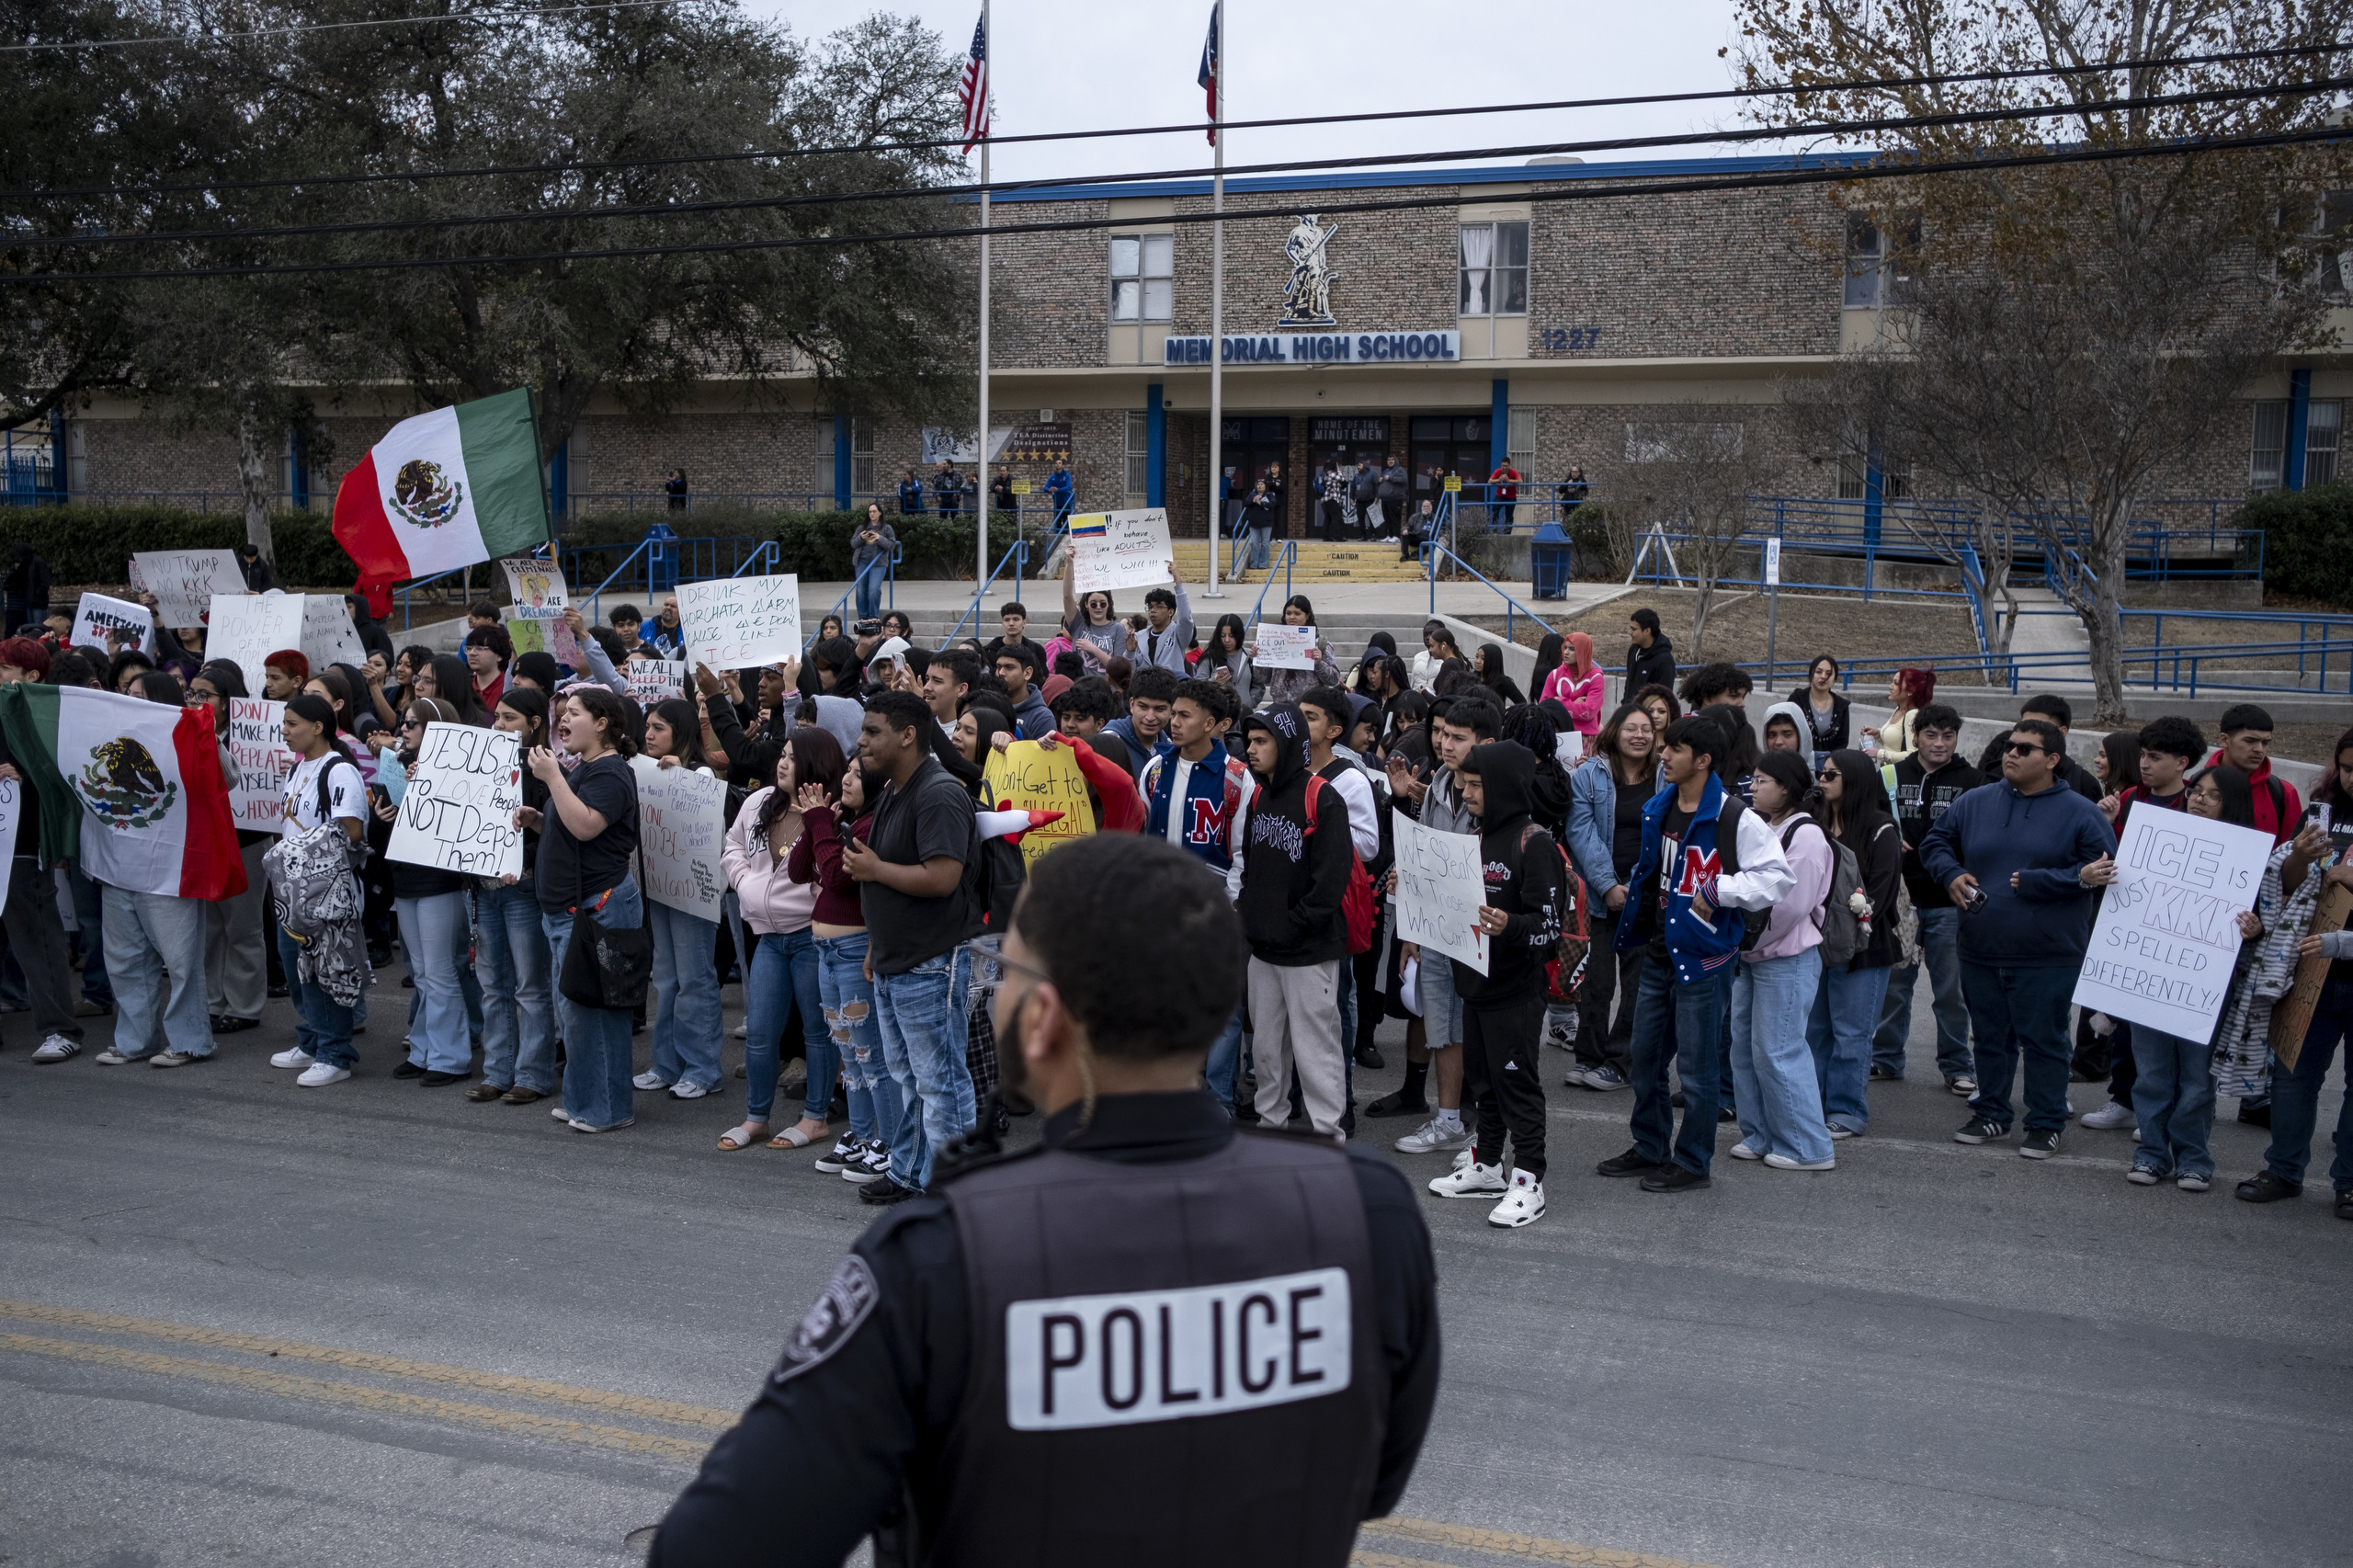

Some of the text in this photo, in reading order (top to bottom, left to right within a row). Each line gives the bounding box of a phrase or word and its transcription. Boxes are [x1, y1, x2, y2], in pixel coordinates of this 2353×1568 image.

[1166, 334, 1454, 362] MEMORIAL HIGH SCHOOL
[1541, 327, 1600, 348] 1227
[1314, 429, 1382, 440] MINUTEMEN
[1318, 420, 1342, 429] HOME
[1363, 420, 1380, 429] THE
[1127, 519, 1138, 529] you
[152, 555, 219, 575] NO TRUMP
[157, 579, 173, 593] NO
[182, 575, 215, 594] KKK
[688, 585, 745, 604] DRINK
[754, 577, 783, 597] MY
[160, 596, 179, 606] NO
[244, 597, 276, 614] THE
[519, 607, 563, 619] DREAMERS
[547, 597, 562, 606] ARE
[681, 597, 795, 629] HORCHATA WARM
[221, 615, 283, 637] POWER
[740, 628, 779, 641] LIKE
[239, 638, 271, 649] OF THE
[706, 643, 756, 665] ICE
[631, 660, 675, 676] WE ALL
[630, 675, 684, 687] BLEED THE
[232, 722, 283, 743] MAKE M
[231, 741, 287, 773] REPEAT
[418, 728, 506, 774] JESUS
[691, 773, 721, 797] SPEAK
[1023, 764, 1057, 795] Get
[1064, 767, 1083, 798] to
[435, 771, 489, 805] LOVE
[489, 788, 520, 817] People
[397, 795, 460, 835] NOT
[1190, 798, 1225, 845] M
[1396, 818, 1430, 871] WE
[434, 838, 505, 877] Them!
[2130, 824, 2249, 890] ICE IS
[1677, 846, 1722, 897] M
[2109, 877, 2249, 950] JUST KKK
[2106, 926, 2207, 971] SPELLED
[2082, 957, 2220, 1010] DIFFERENTLY!
[1042, 1287, 1324, 1415] POLICE
